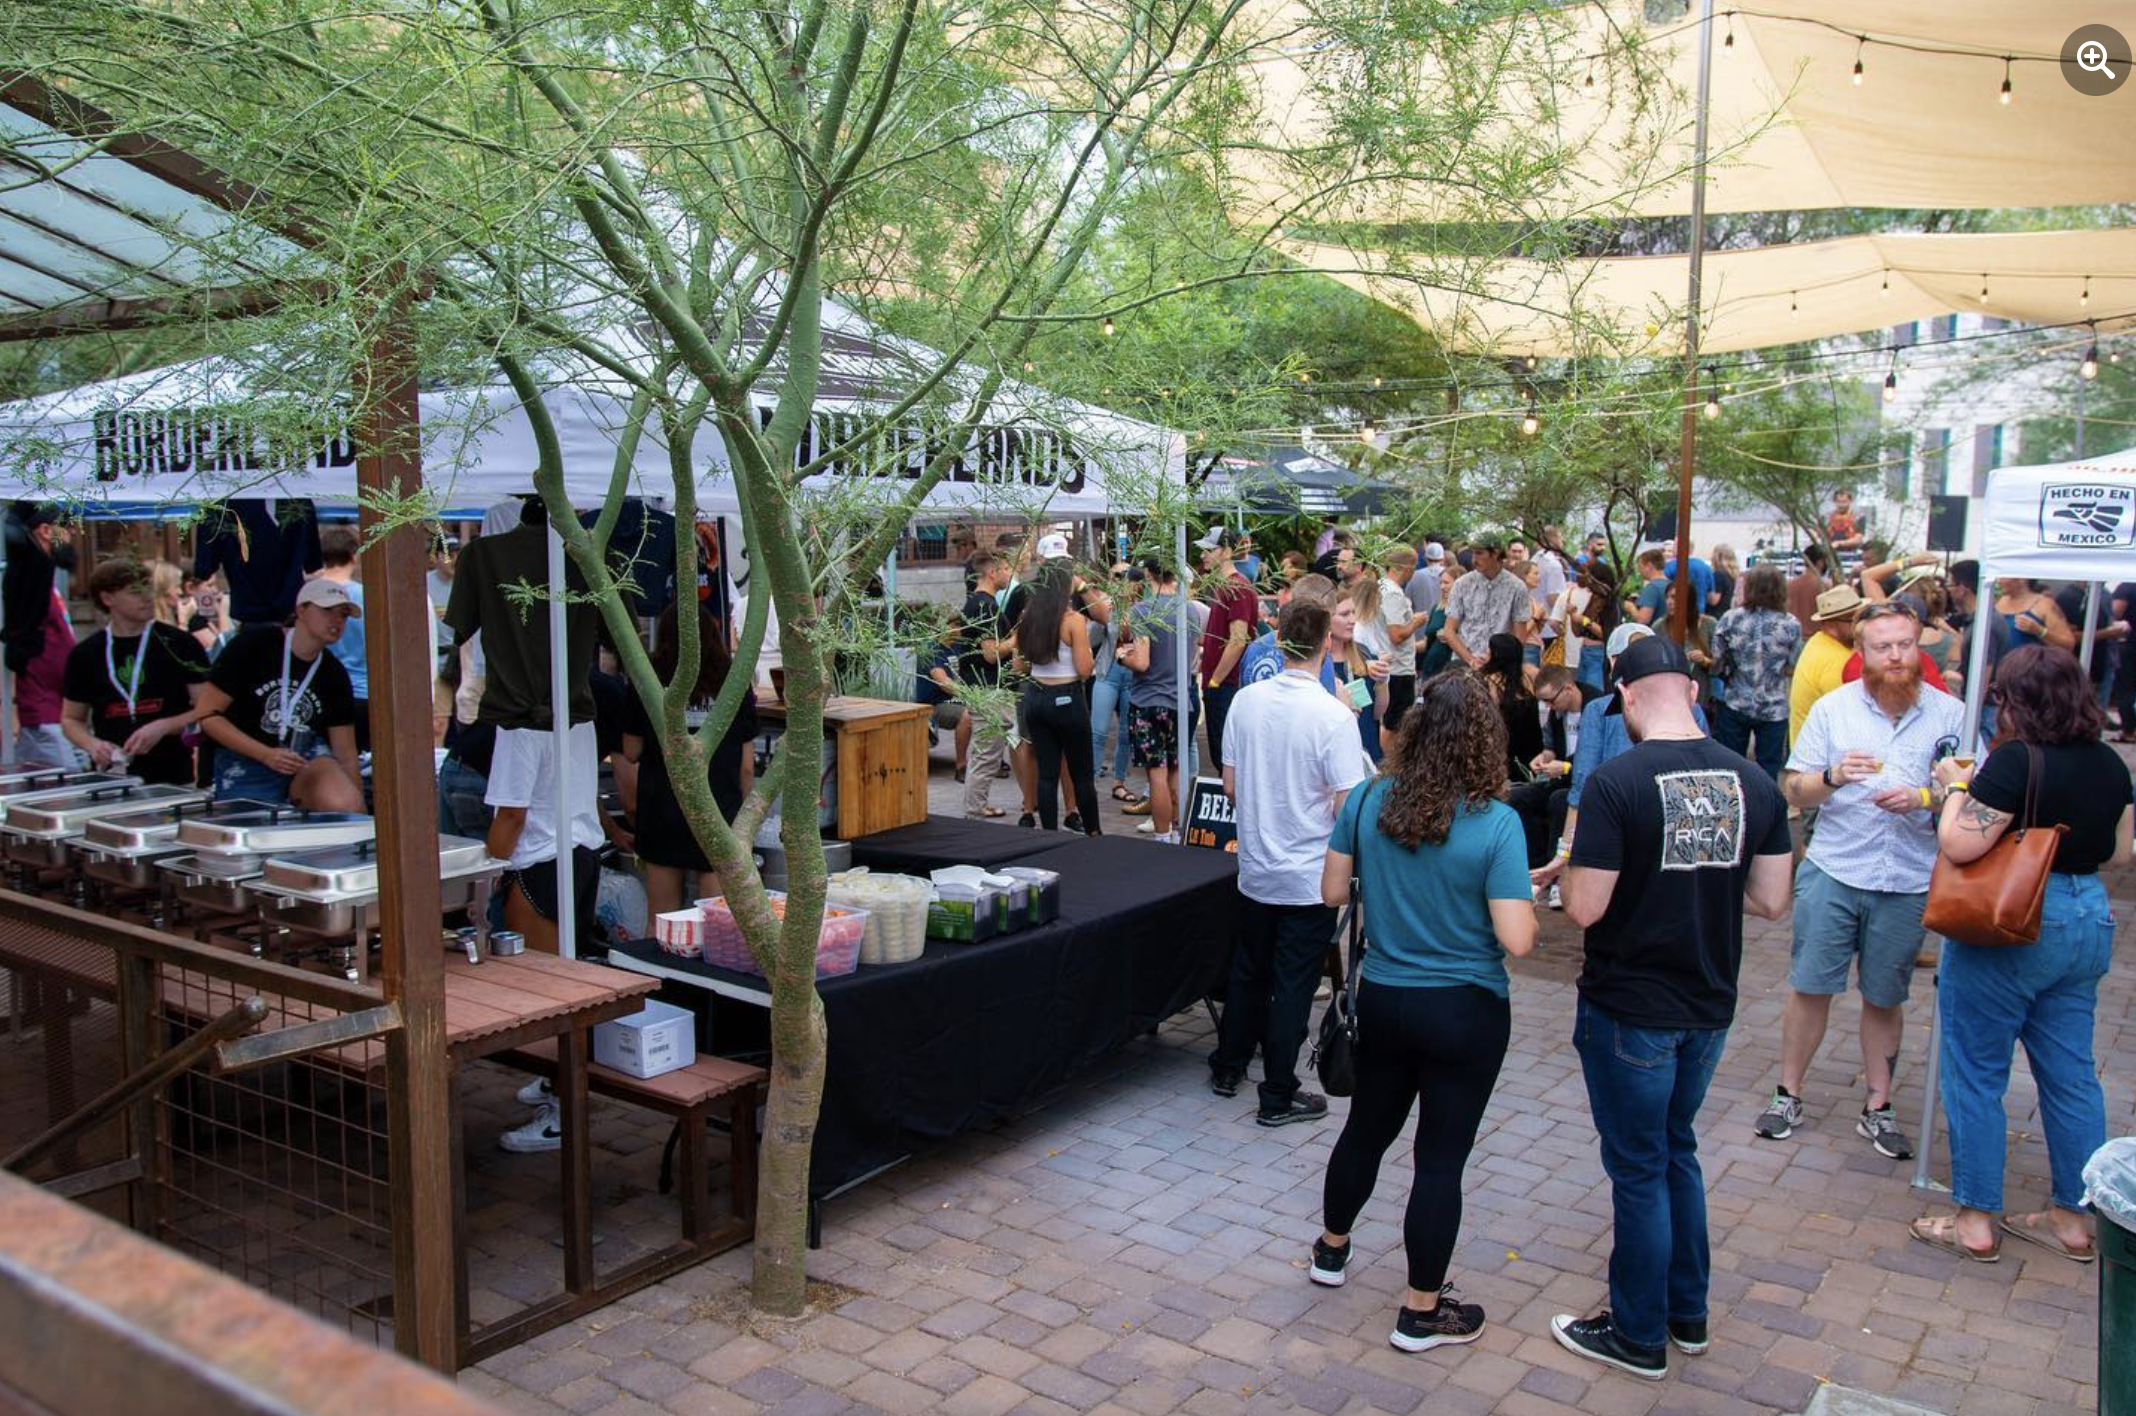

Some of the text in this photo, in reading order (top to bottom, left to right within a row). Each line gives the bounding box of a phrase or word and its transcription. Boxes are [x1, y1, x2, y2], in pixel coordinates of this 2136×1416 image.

[2051, 488, 2130, 499] HECHO EN
[2058, 533, 2117, 543] MEXICO
[1198, 792, 1237, 823] BEE
